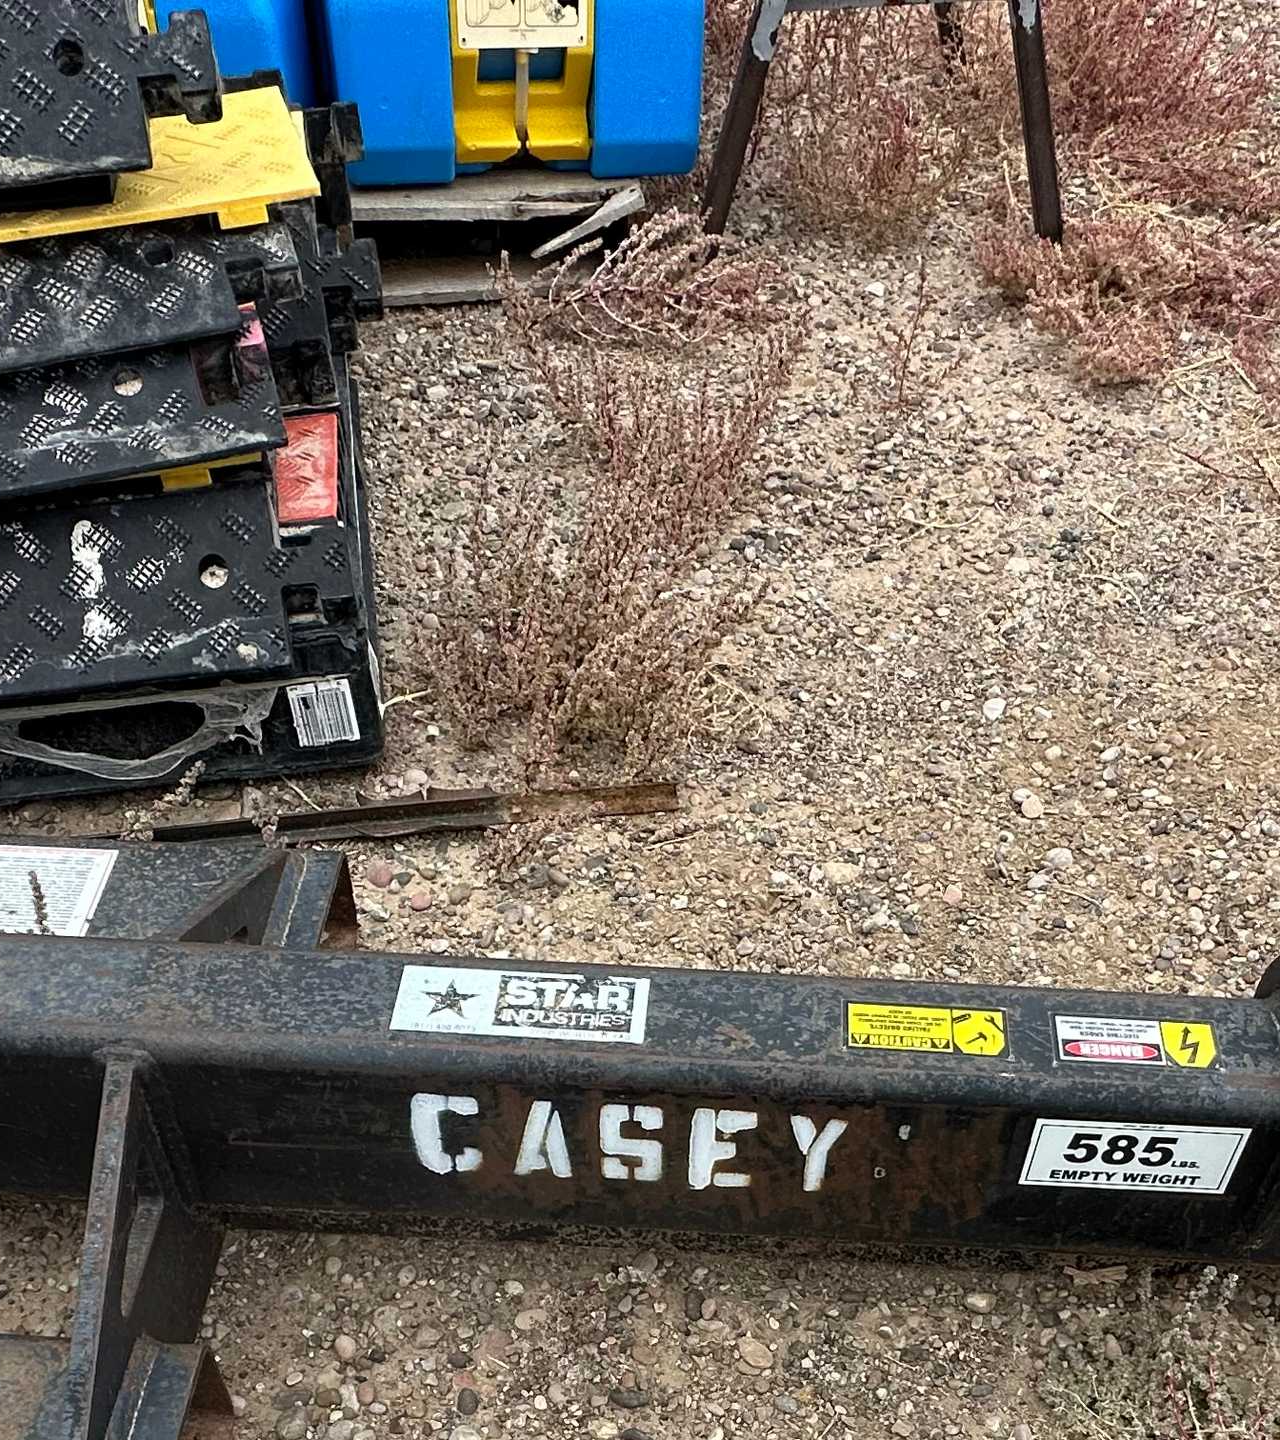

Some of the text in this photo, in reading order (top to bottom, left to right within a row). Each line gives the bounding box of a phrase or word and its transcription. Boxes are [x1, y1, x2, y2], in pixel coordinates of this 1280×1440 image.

[506, 977, 630, 1013] STAR
[499, 1008, 631, 1028] INDUSTRIES
[869, 1034, 932, 1049] CAUTION
[1079, 1043, 1144, 1058] DANGER
[411, 1093, 848, 1193] CASEY
[1063, 1133, 1200, 1169] 585 LBS.
[1049, 1169, 1201, 1186] EMPTY WEIGHT
